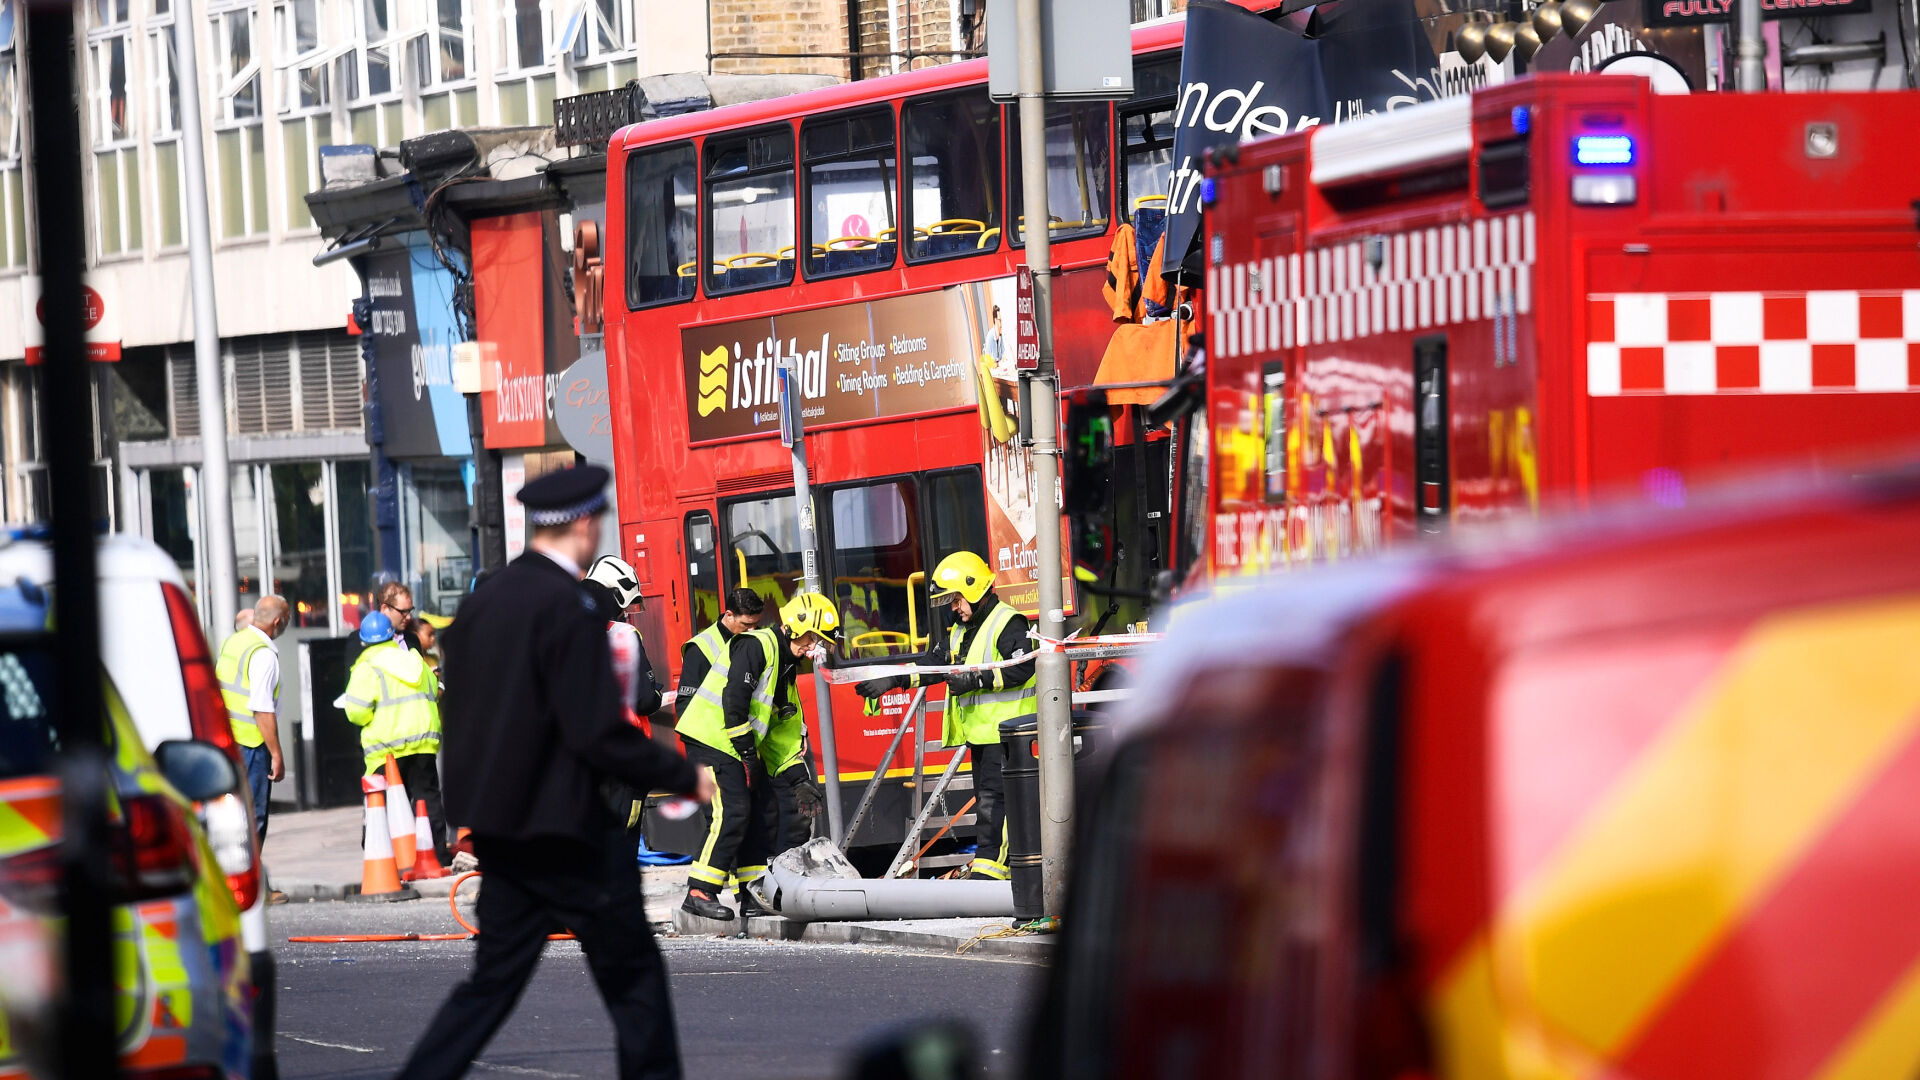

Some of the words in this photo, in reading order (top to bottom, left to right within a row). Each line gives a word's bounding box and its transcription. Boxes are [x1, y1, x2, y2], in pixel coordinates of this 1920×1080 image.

[1663, 0, 1734, 18] FULLY
[1018, 296, 1032, 314] RIGHT
[1020, 319, 1034, 337] TURN
[838, 342, 861, 366] Sitting
[861, 340, 886, 363] Groups
[892, 333, 927, 356] Bedrooms
[1017, 342, 1037, 360] AHEAD
[840, 372, 863, 396] Dining
[862, 370, 888, 390] Rooms
[895, 362, 924, 388] Bedding
[923, 361, 931, 381] &
[930, 358, 966, 384] Carpeting
[495, 360, 544, 423] Bairstow
